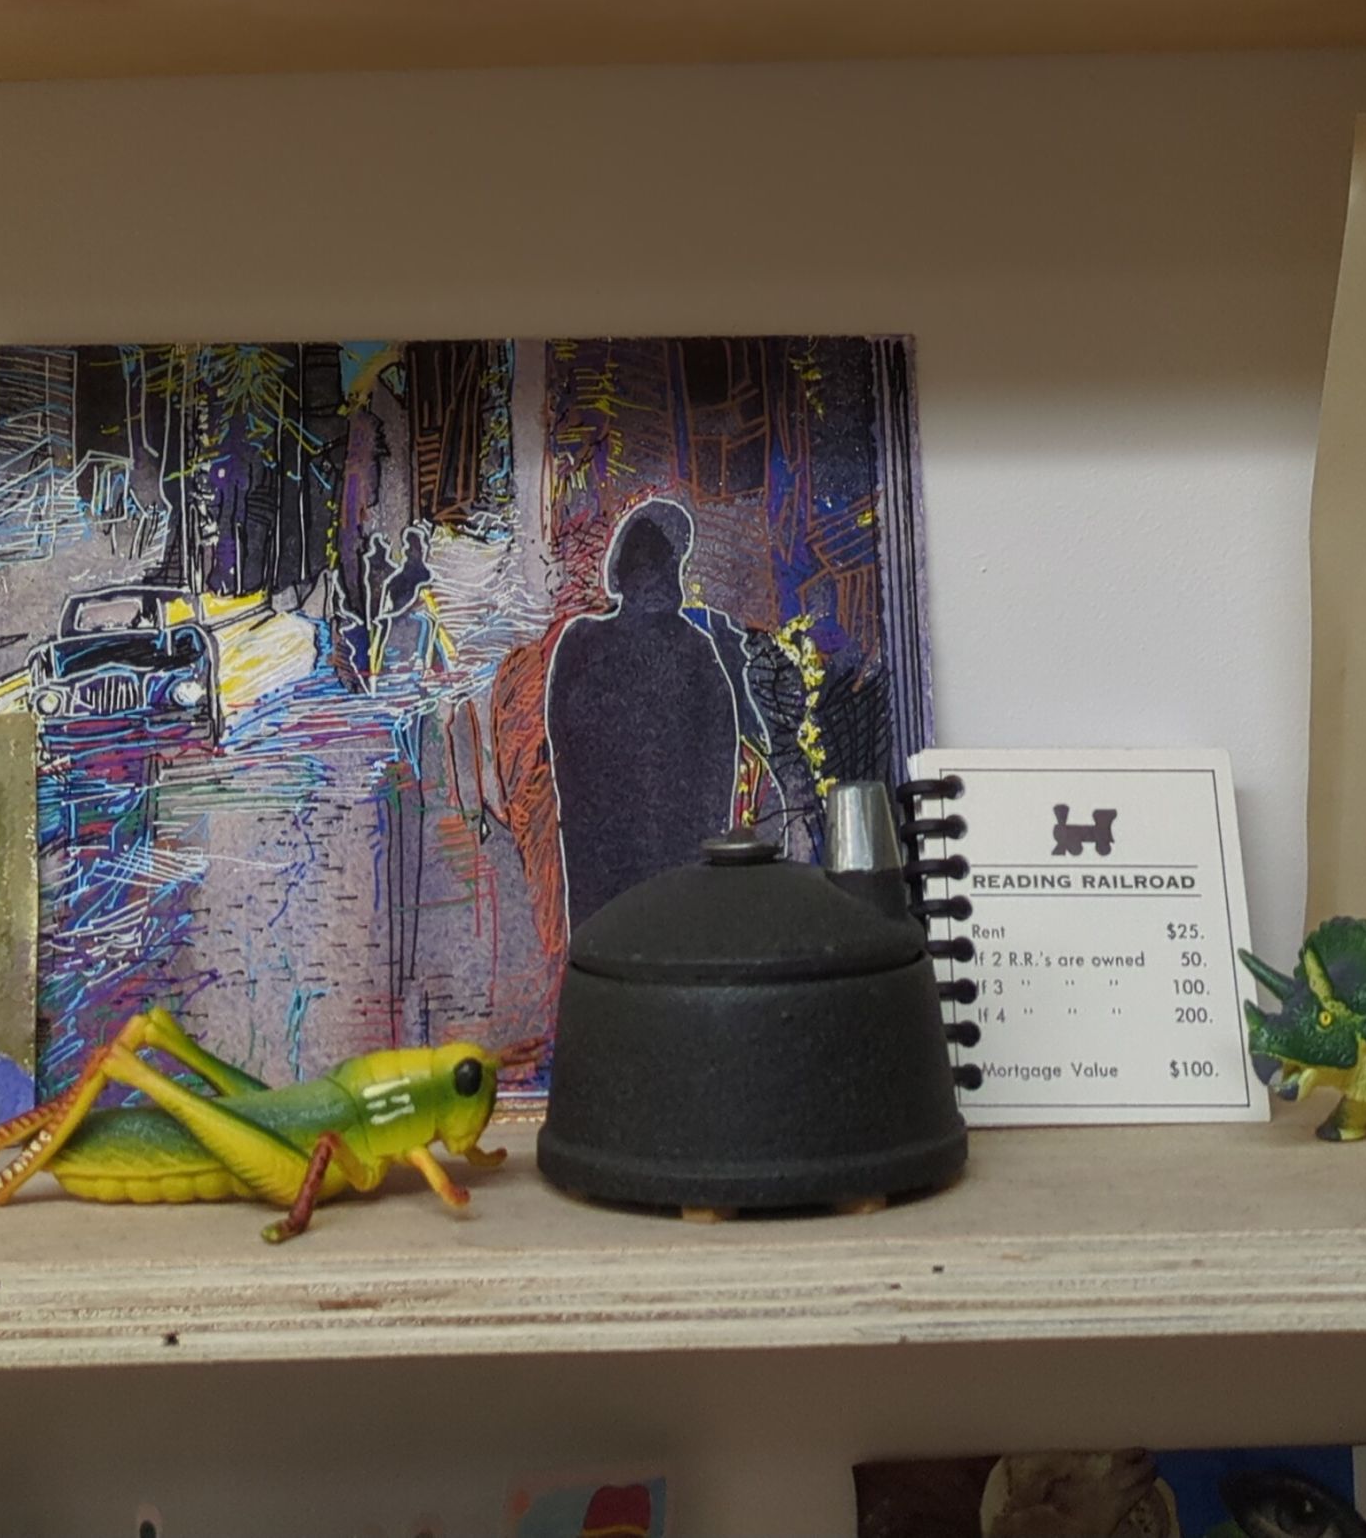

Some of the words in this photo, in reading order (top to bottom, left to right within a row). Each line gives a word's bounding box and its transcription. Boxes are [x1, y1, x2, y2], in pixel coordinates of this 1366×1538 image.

[972, 874, 1072, 890] READING
[1081, 874, 1197, 890] RAILROAD
[971, 923, 1006, 940] Rent
[1166, 921, 1206, 940] $25.
[992, 952, 1003, 967] 2
[1009, 951, 1052, 967] R.R.'s
[1058, 955, 1085, 967] are
[1091, 950, 1146, 967] owned
[1181, 951, 1208, 967] 50.
[993, 979, 1004, 995] 3
[1173, 979, 1211, 995] 100.
[978, 1007, 989, 1023] If
[996, 1007, 1006, 1023] 4
[1175, 1007, 1214, 1024] 200.
[981, 1061, 1062, 1081] Mortgage
[1071, 1062, 1119, 1077] Value
[1169, 1059, 1220, 1078] $100.
